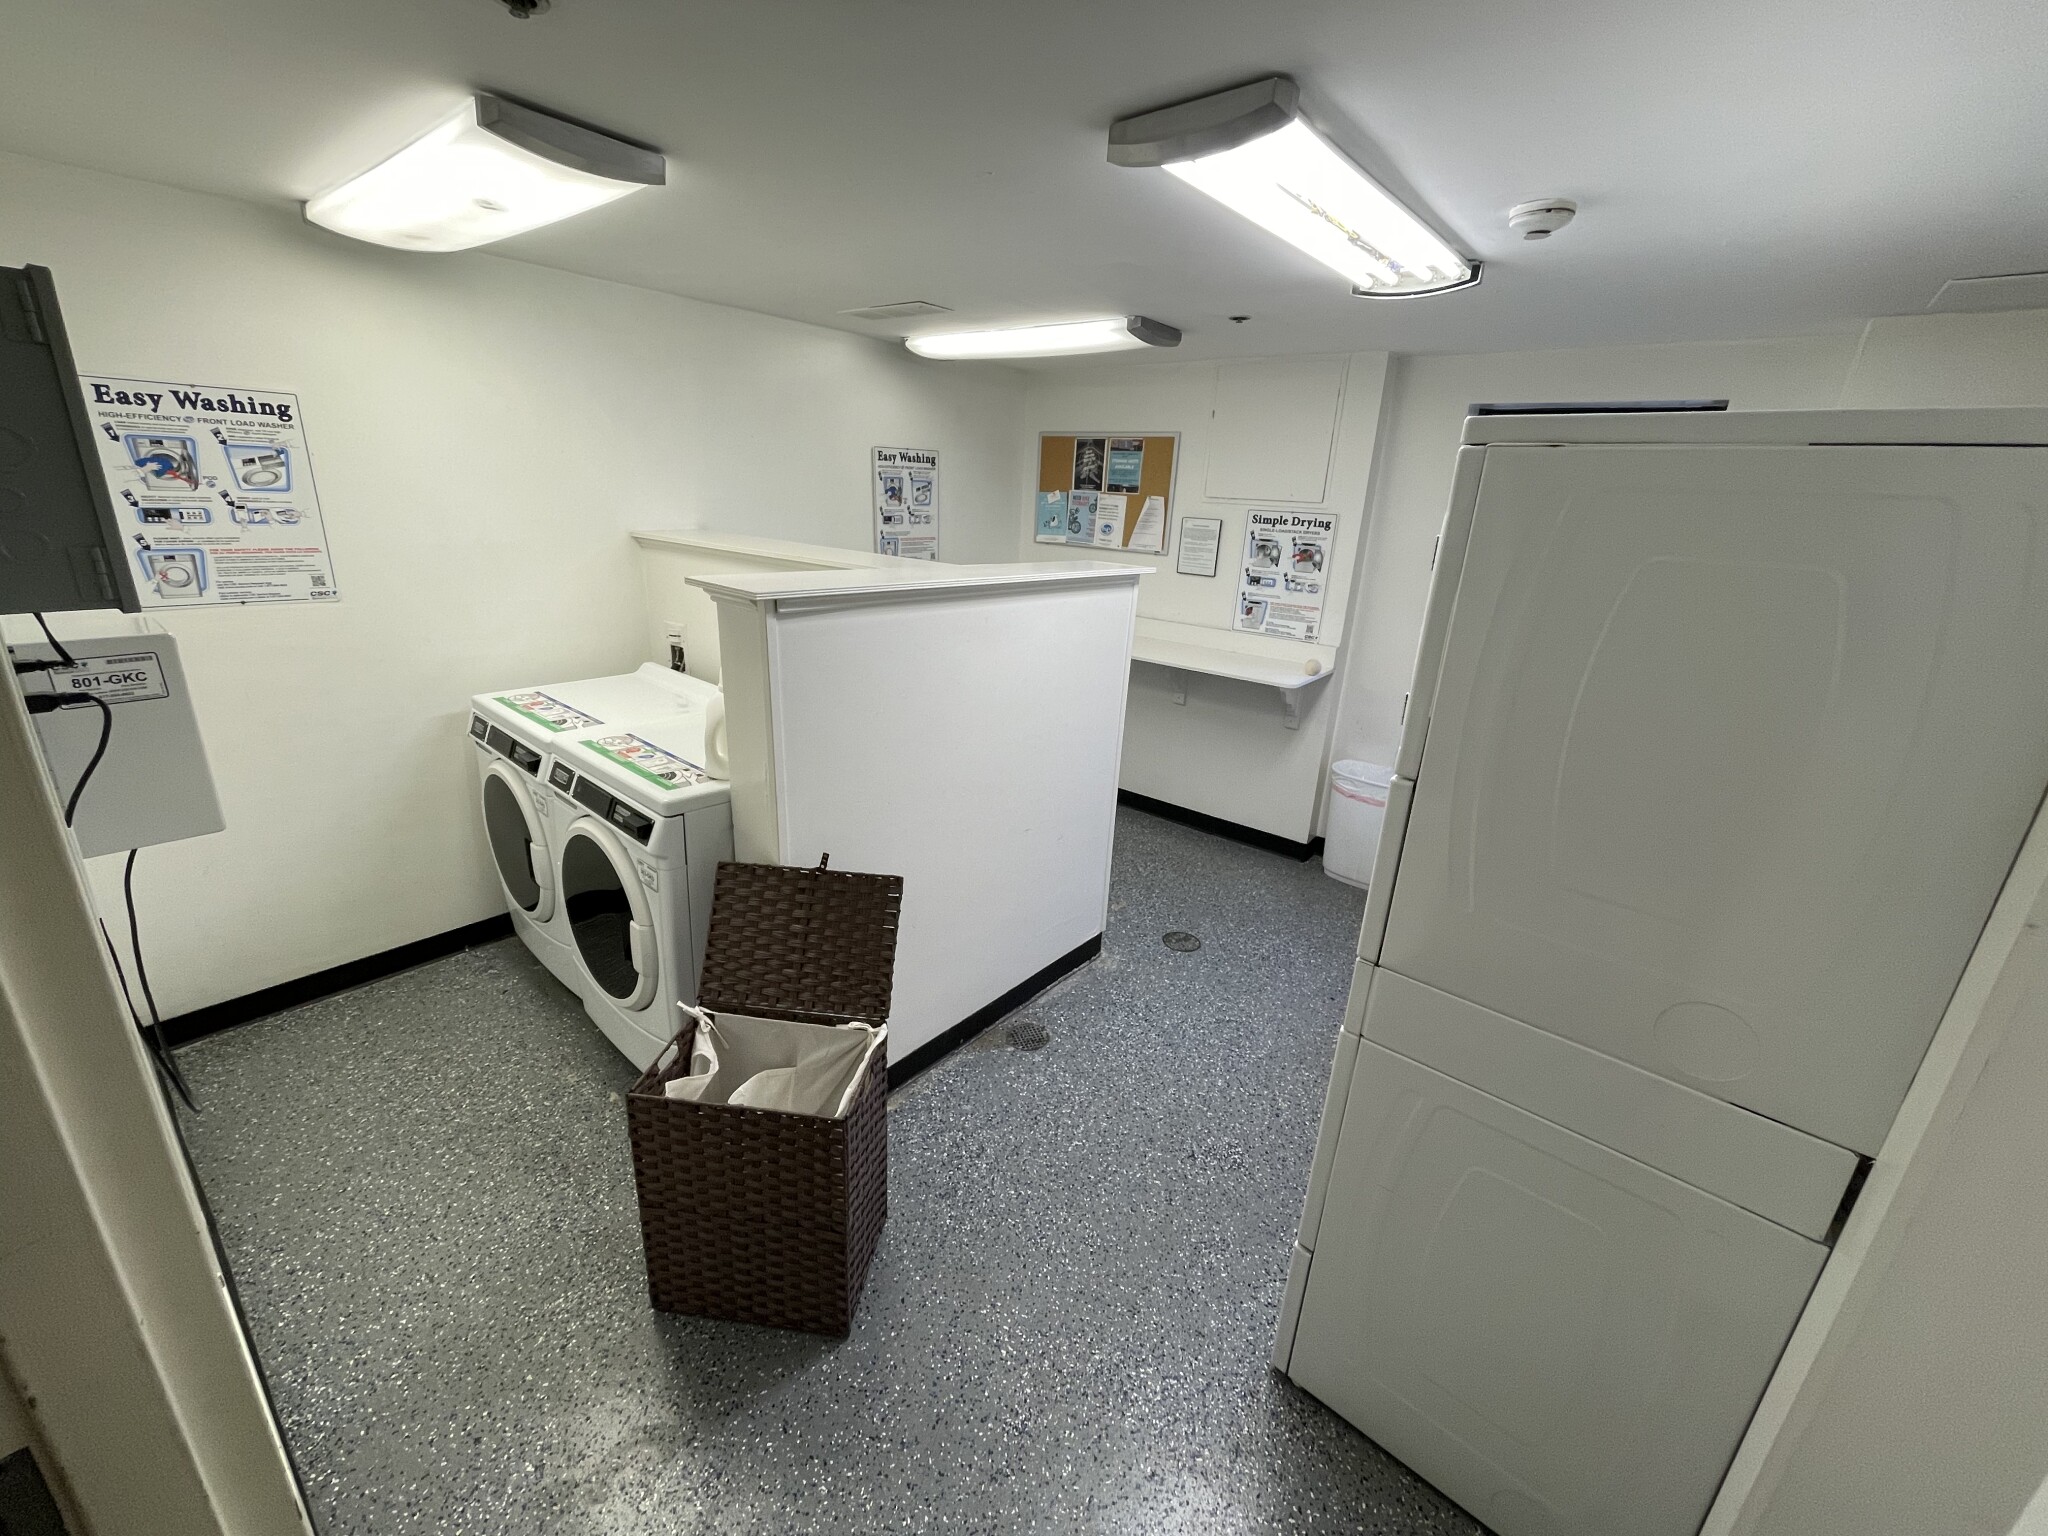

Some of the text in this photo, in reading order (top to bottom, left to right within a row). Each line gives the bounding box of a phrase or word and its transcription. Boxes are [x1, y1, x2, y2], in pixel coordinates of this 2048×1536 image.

[90, 383, 292, 422] Easy Washing
[98, 410, 295, 431] HIGH-EFFICIENCY FRONT LOAD WASHER
[877, 450, 936, 466] Easy Washing
[1251, 514, 1332, 531] Simple Drying
[71, 671, 148, 689] 801-GKC
